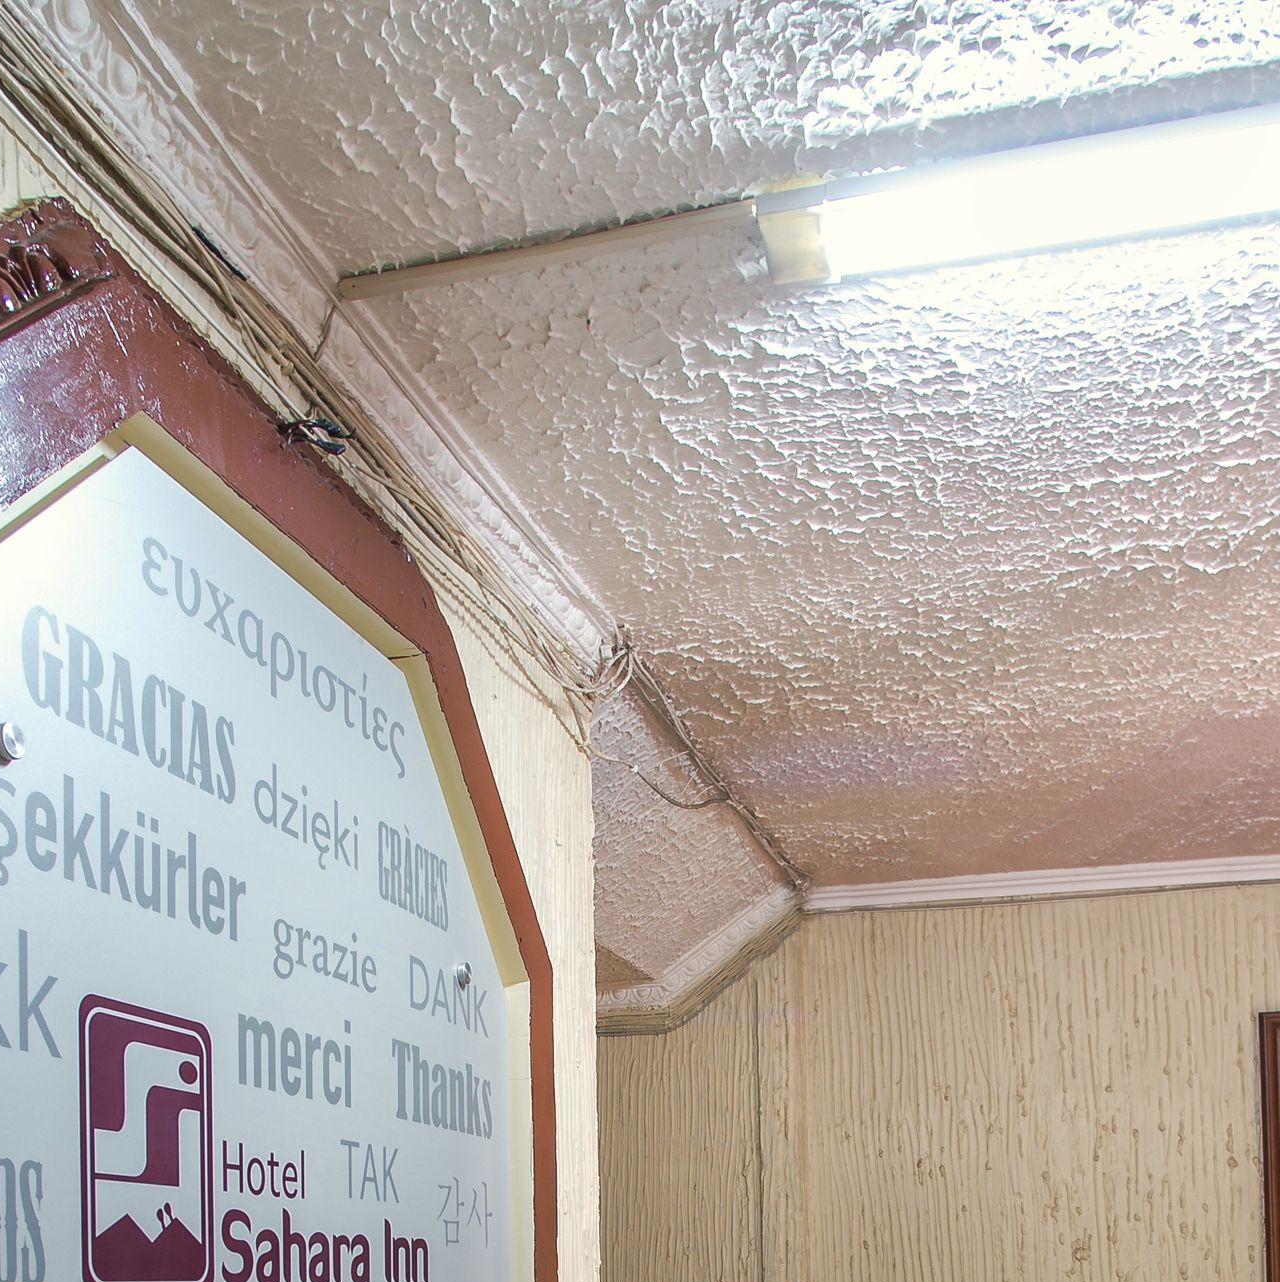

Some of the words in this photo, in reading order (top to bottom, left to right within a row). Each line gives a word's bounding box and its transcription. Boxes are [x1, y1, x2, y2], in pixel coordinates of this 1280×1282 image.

[21, 605, 236, 805] GRACIAS
[141, 536, 406, 779] ευχαριστίες
[253, 763, 359, 871] dzięki
[377, 820, 449, 932] GRÀCIES
[272, 916, 378, 995] grazie
[409, 954, 489, 1038] DANK
[238, 1012, 353, 1108] merci
[391, 1038, 493, 1140] Thanks
[221, 1140, 307, 1201] Hotel
[340, 1139, 400, 1204] TAK
[436, 1176, 493, 1248] 감사
